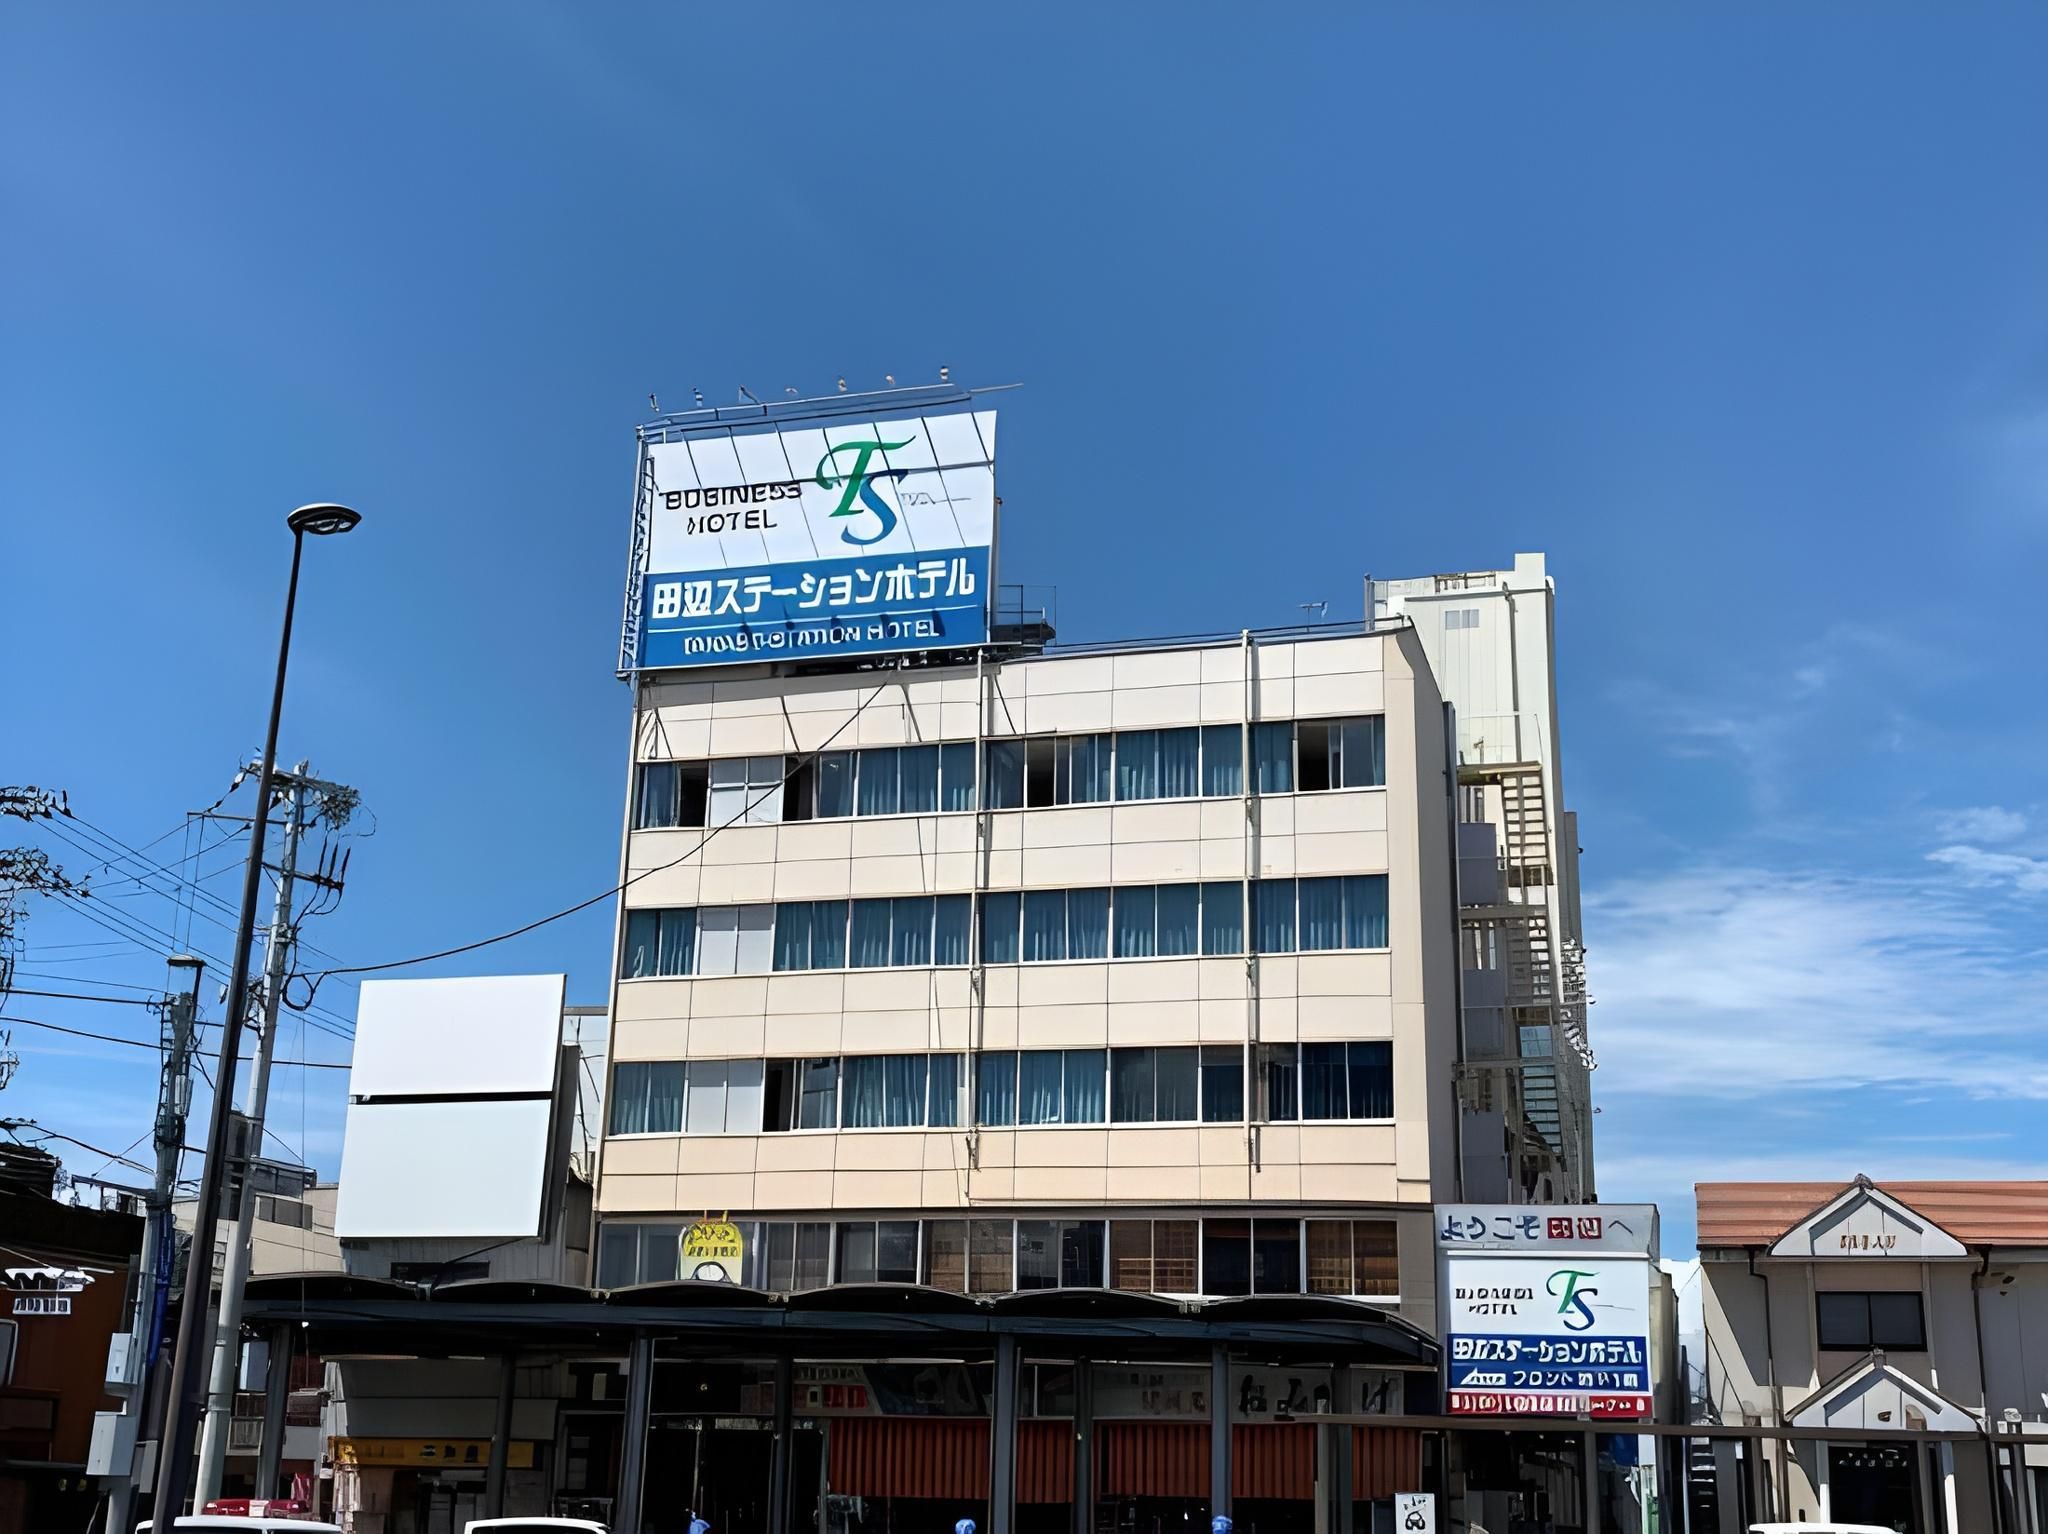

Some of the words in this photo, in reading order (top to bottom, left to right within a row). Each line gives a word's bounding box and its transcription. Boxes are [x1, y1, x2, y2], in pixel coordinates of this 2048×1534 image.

[652, 557, 975, 619] 田辺ステーションホテル
